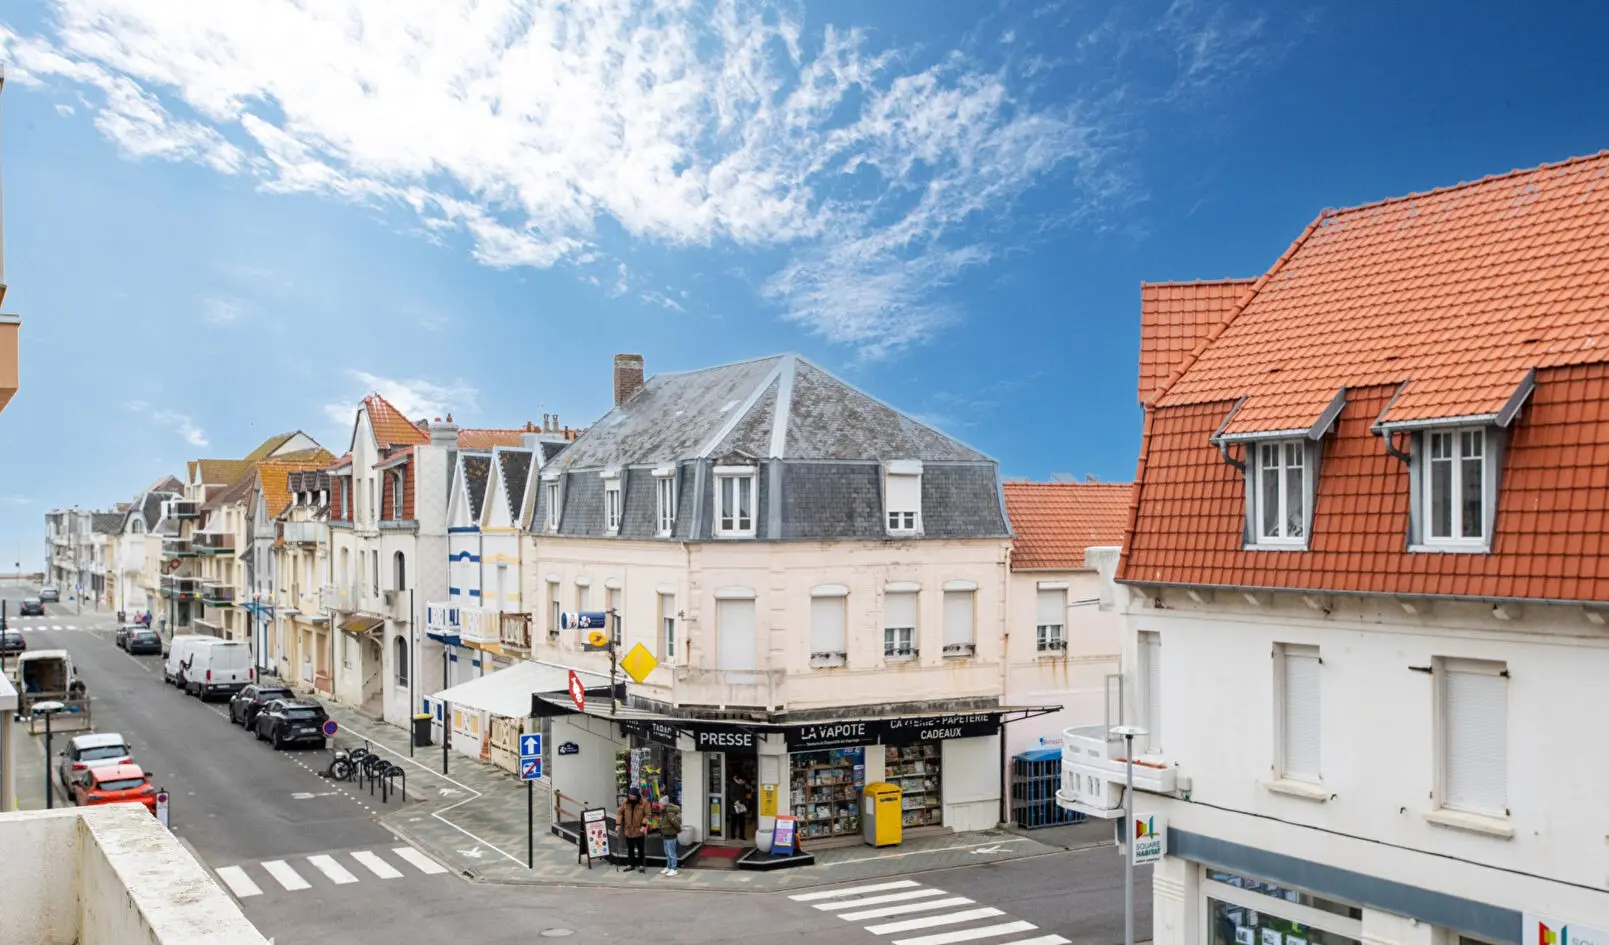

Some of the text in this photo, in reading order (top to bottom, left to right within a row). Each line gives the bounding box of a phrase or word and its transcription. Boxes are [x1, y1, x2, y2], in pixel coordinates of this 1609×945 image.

[801, 723, 866, 740] LA VAPOTE
[920, 727, 962, 740] CADEAUX
[700, 732, 752, 746] PRESSE
[1135, 840, 1161, 850] SQUARE
